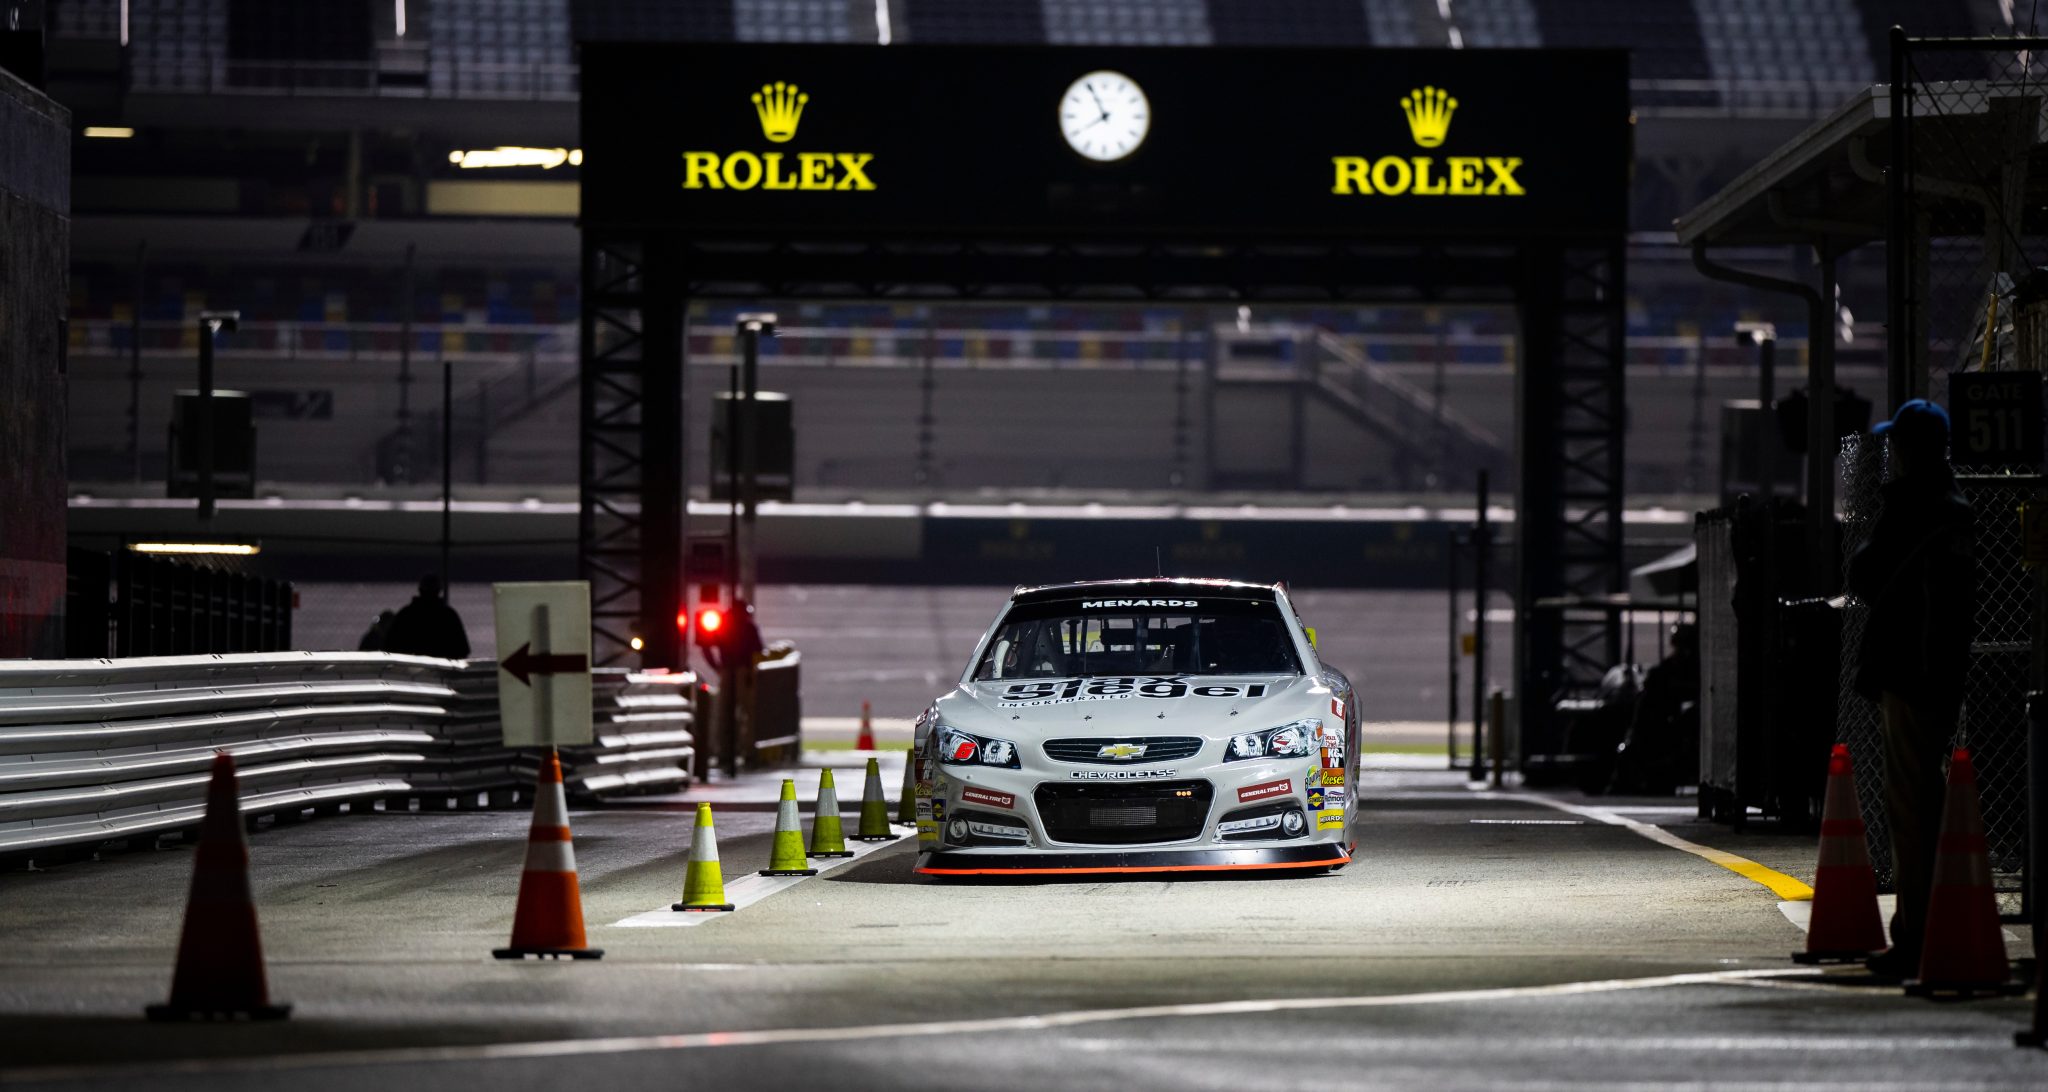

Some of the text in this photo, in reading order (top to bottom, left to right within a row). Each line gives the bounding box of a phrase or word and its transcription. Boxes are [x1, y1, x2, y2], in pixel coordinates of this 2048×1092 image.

[682, 151, 877, 190] ROLEX
[1331, 155, 1526, 195] ROLEX
[1967, 383, 2024, 400] GATE
[1967, 407, 2024, 453] 511
[1082, 599, 1199, 609] MENARDS
[1001, 693, 1129, 707] INCORPORATED
[953, 741, 978, 760] 6
[1070, 768, 1177, 780] CHEVROLET SS
[1240, 785, 1279, 798] GENERAL TIRE
